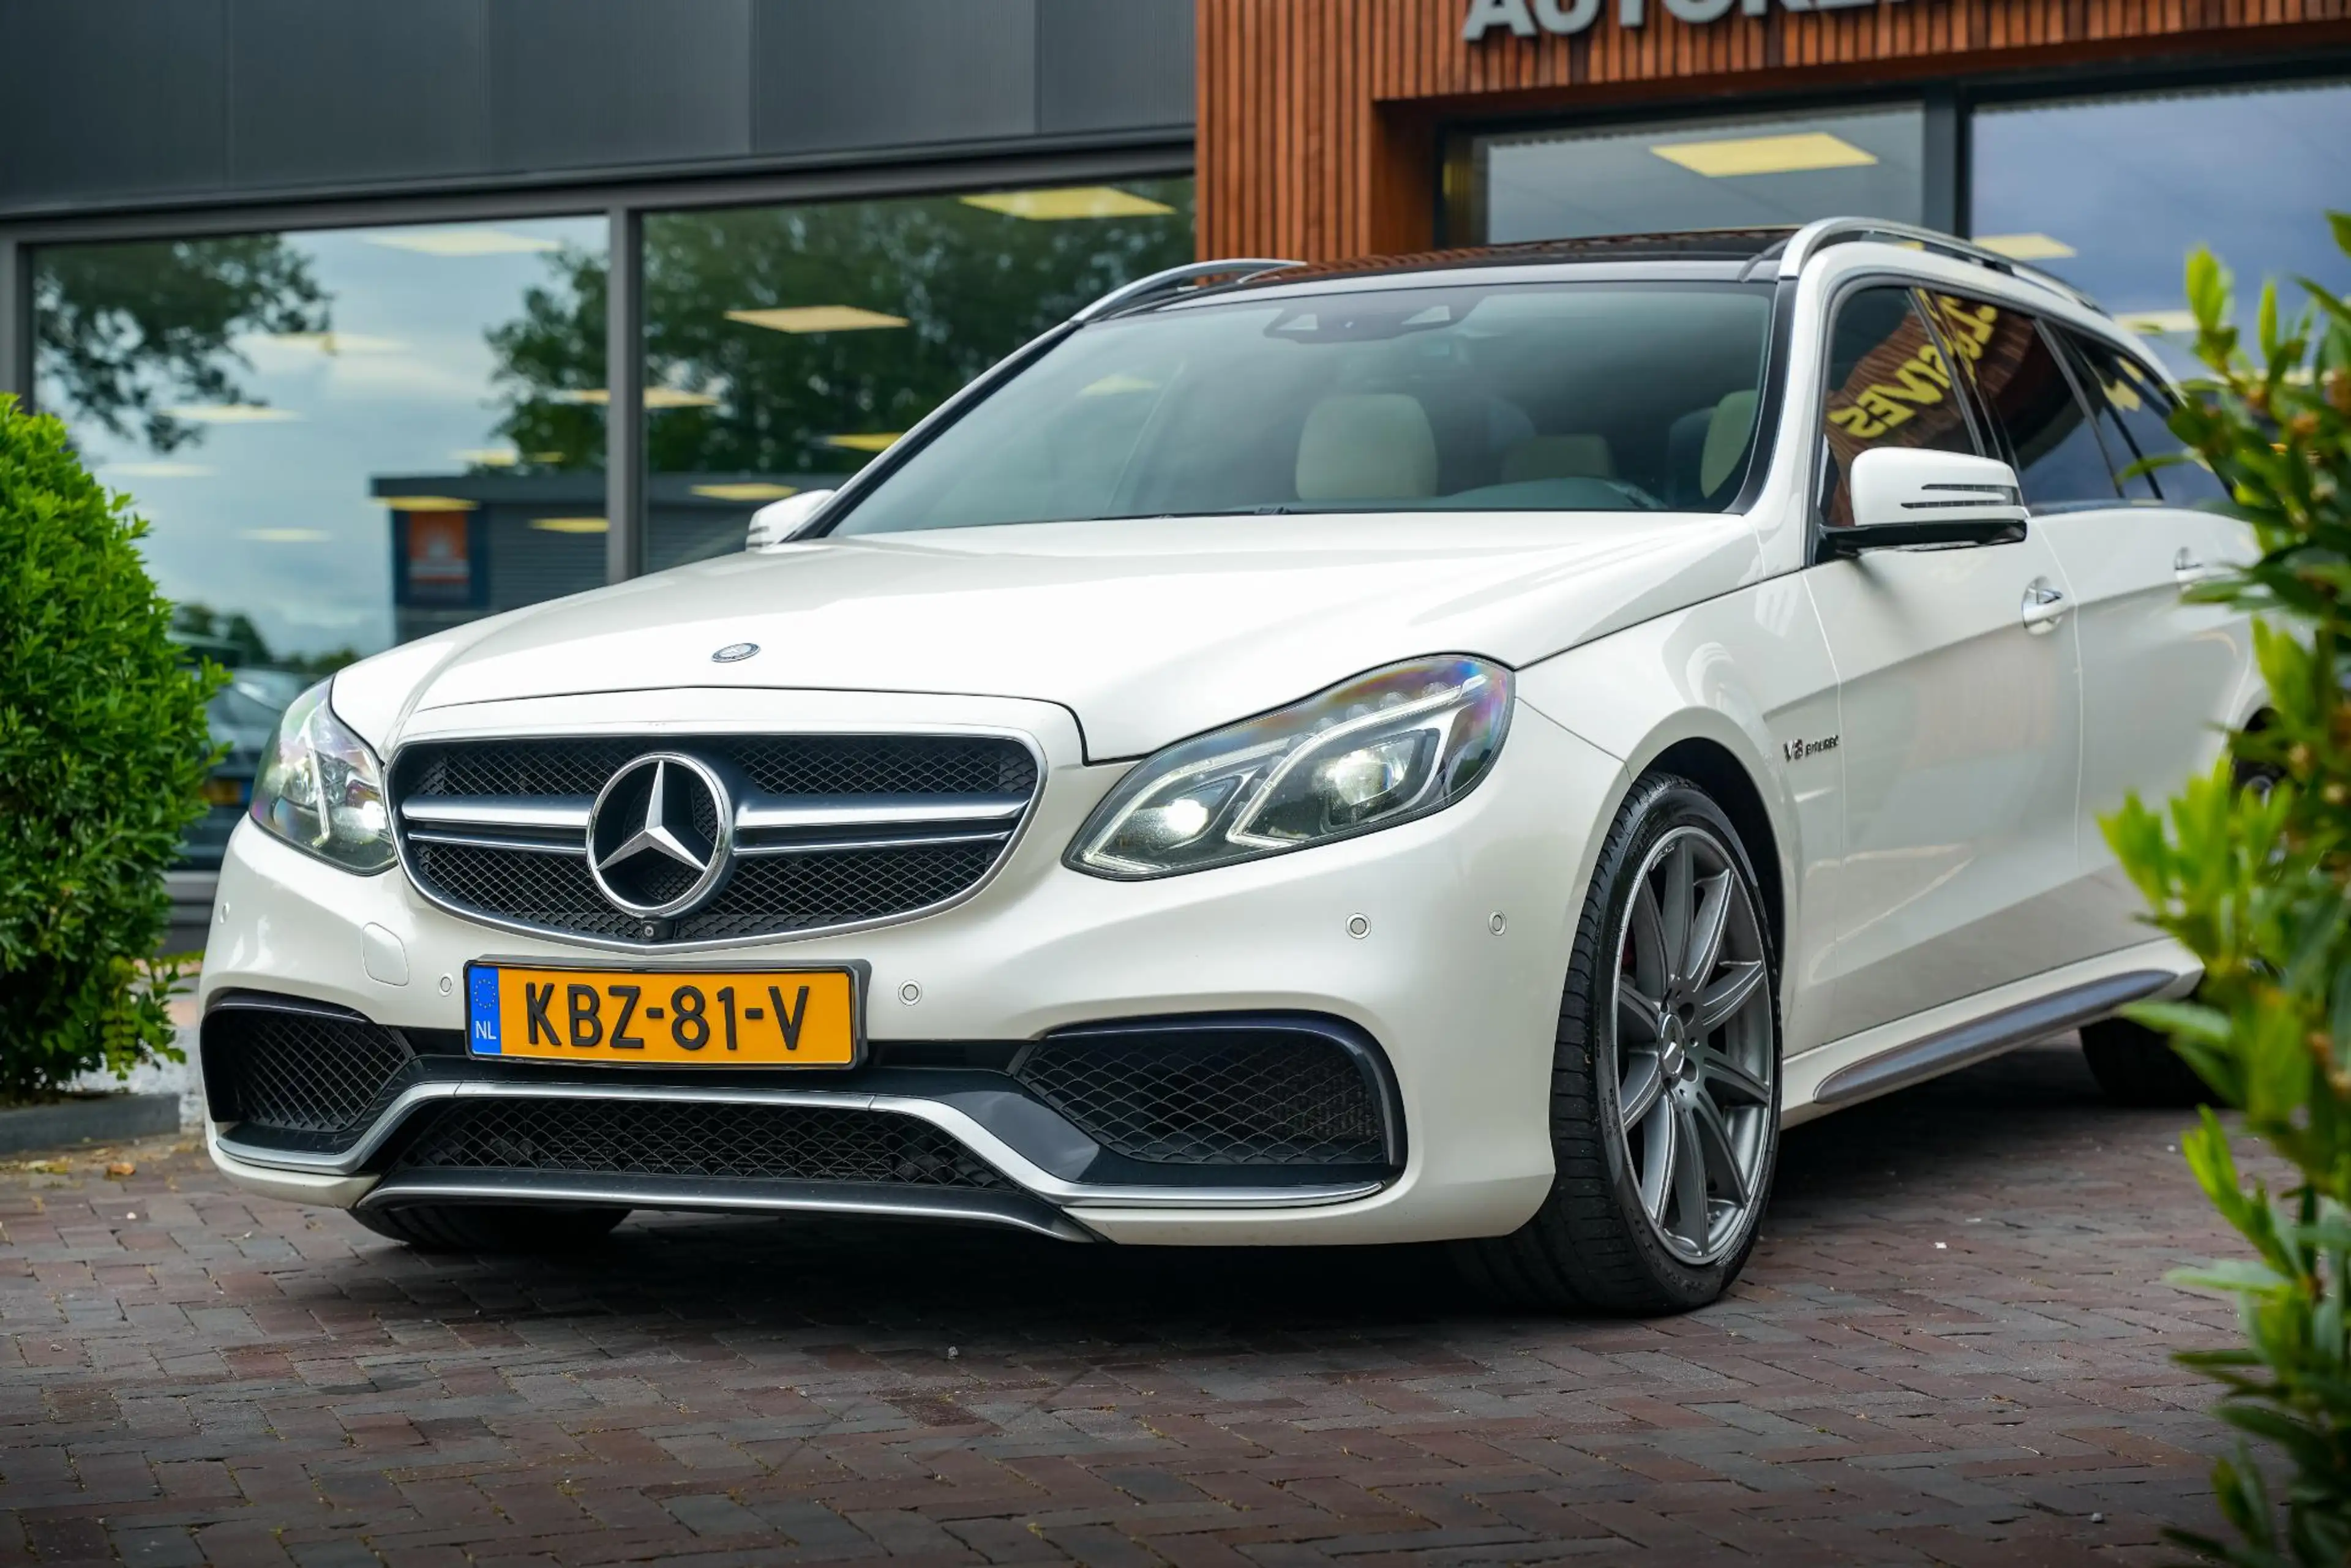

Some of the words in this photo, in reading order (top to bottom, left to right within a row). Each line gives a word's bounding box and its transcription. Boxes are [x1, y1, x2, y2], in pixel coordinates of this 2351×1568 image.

[1783, 738, 1804, 762] V8
[525, 982, 809, 1051] KBZ-81-V
[475, 1020, 497, 1040] NL
